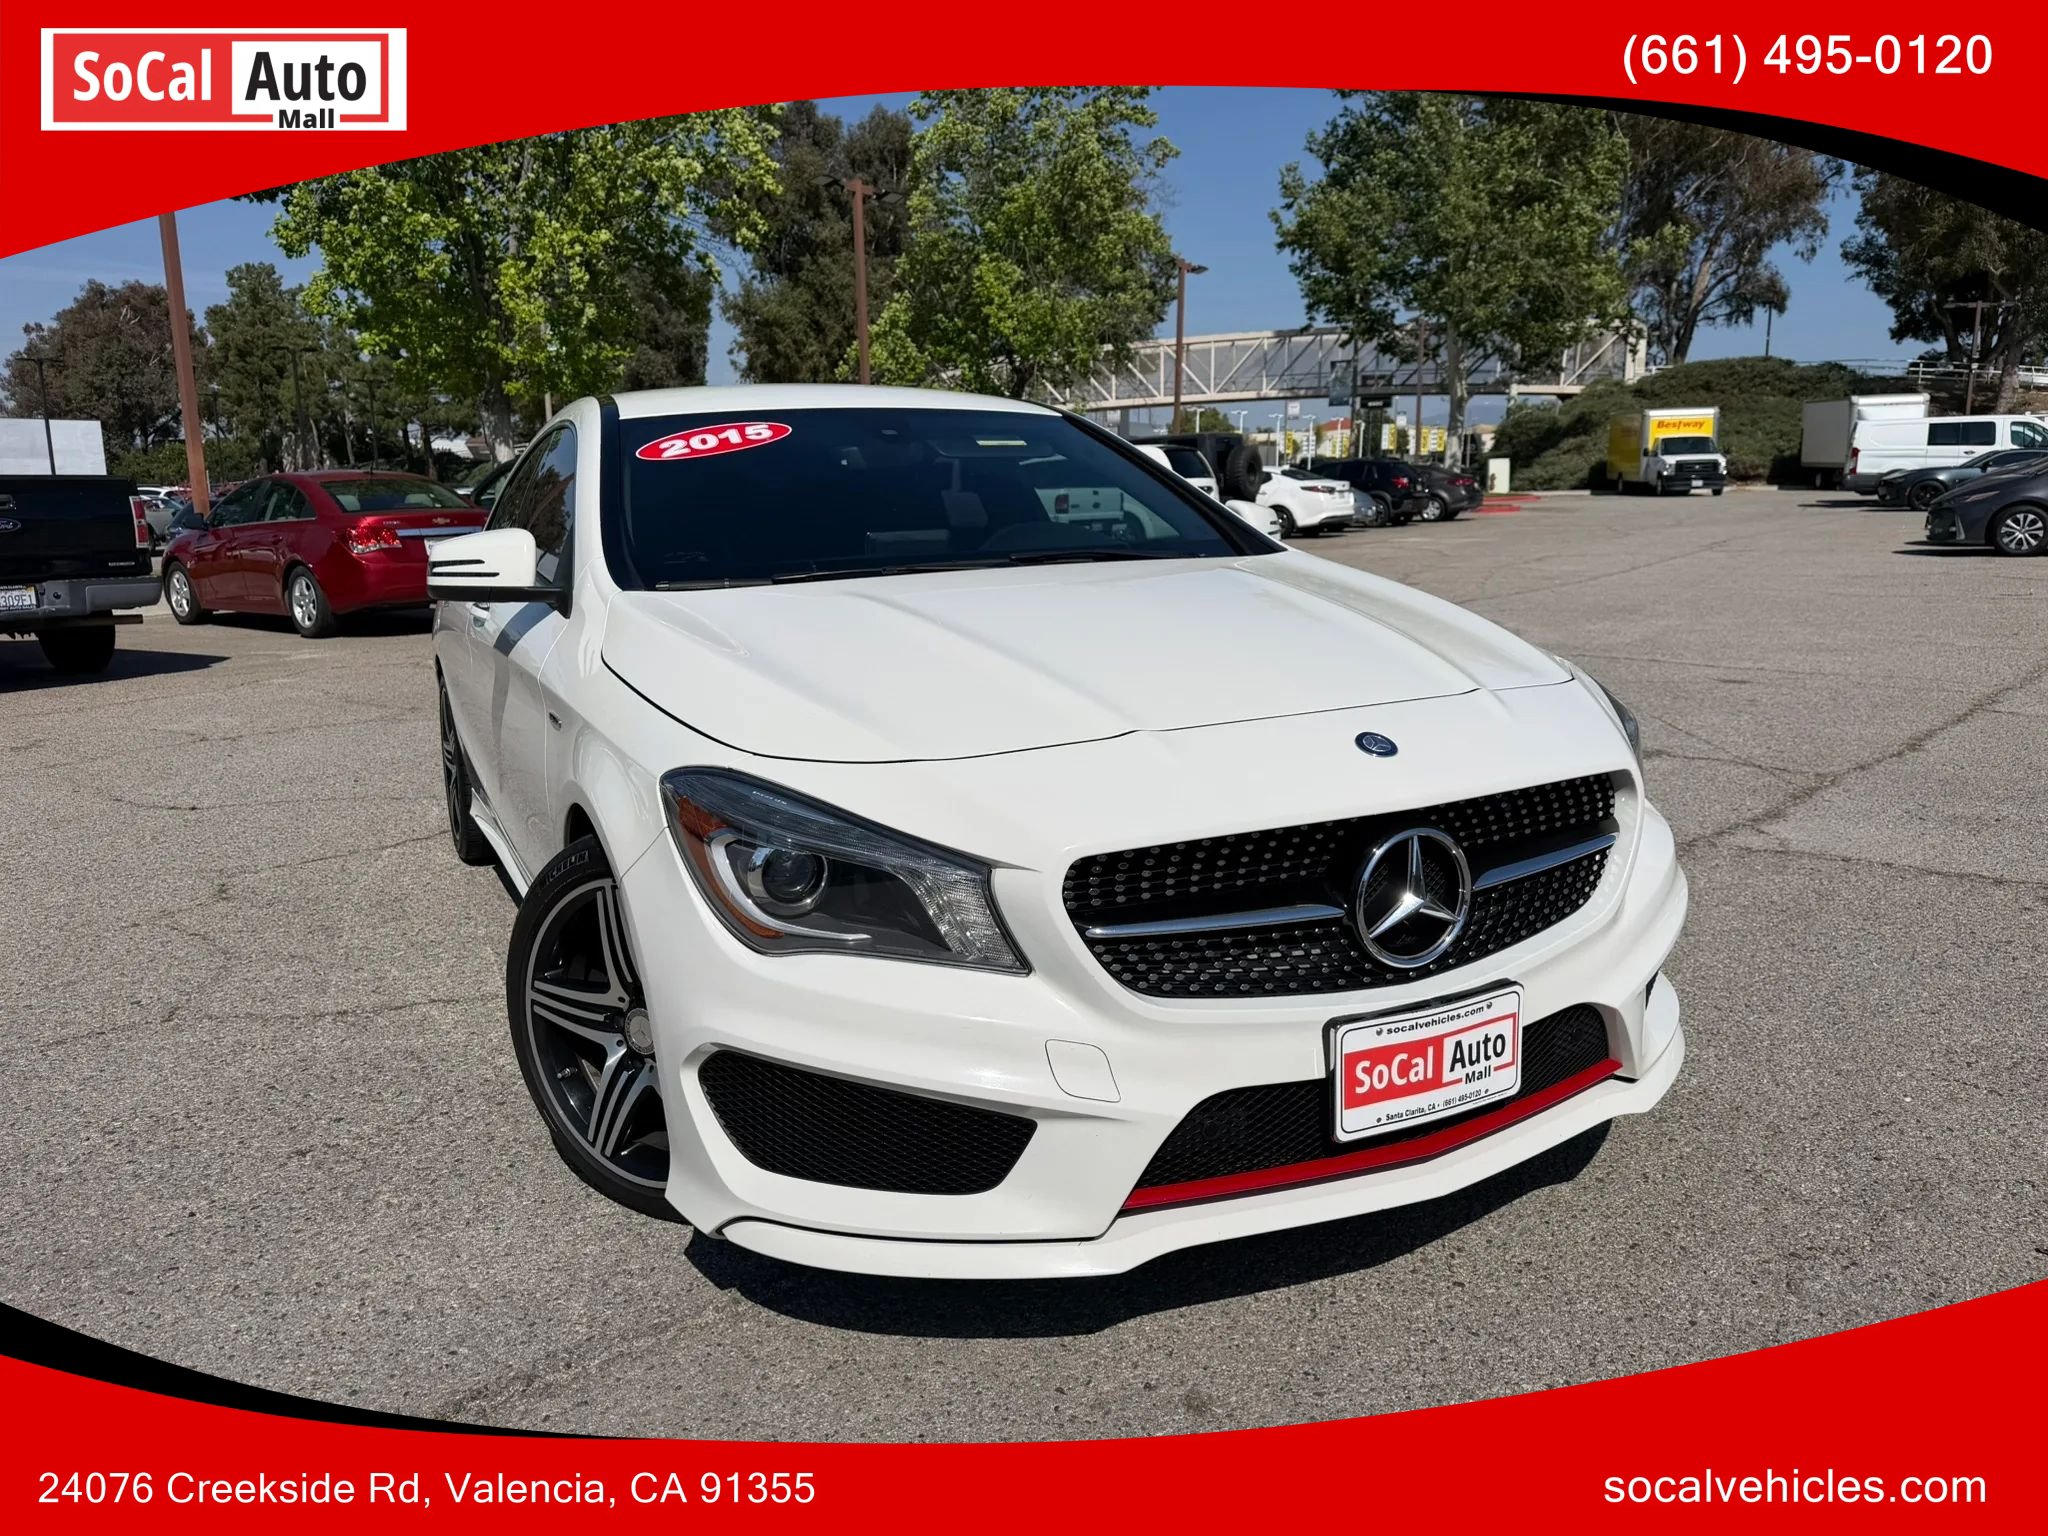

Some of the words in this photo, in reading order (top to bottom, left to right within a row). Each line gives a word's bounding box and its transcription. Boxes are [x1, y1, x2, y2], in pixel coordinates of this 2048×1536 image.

[1657, 420, 1705, 430] Bestway
[659, 424, 773, 458] 2015
[1386, 1005, 1484, 1035] socalvehicles.com
[1355, 1046, 1434, 1094] SoCal
[1449, 1033, 1506, 1072] Auto
[1465, 1065, 1491, 1084] Mall
[1385, 1113, 1404, 1121] Santa
[1427, 1103, 1436, 1111] CA
[1443, 1096, 1457, 1108] (661)
[1458, 1089, 1482, 1103] 495-0120
